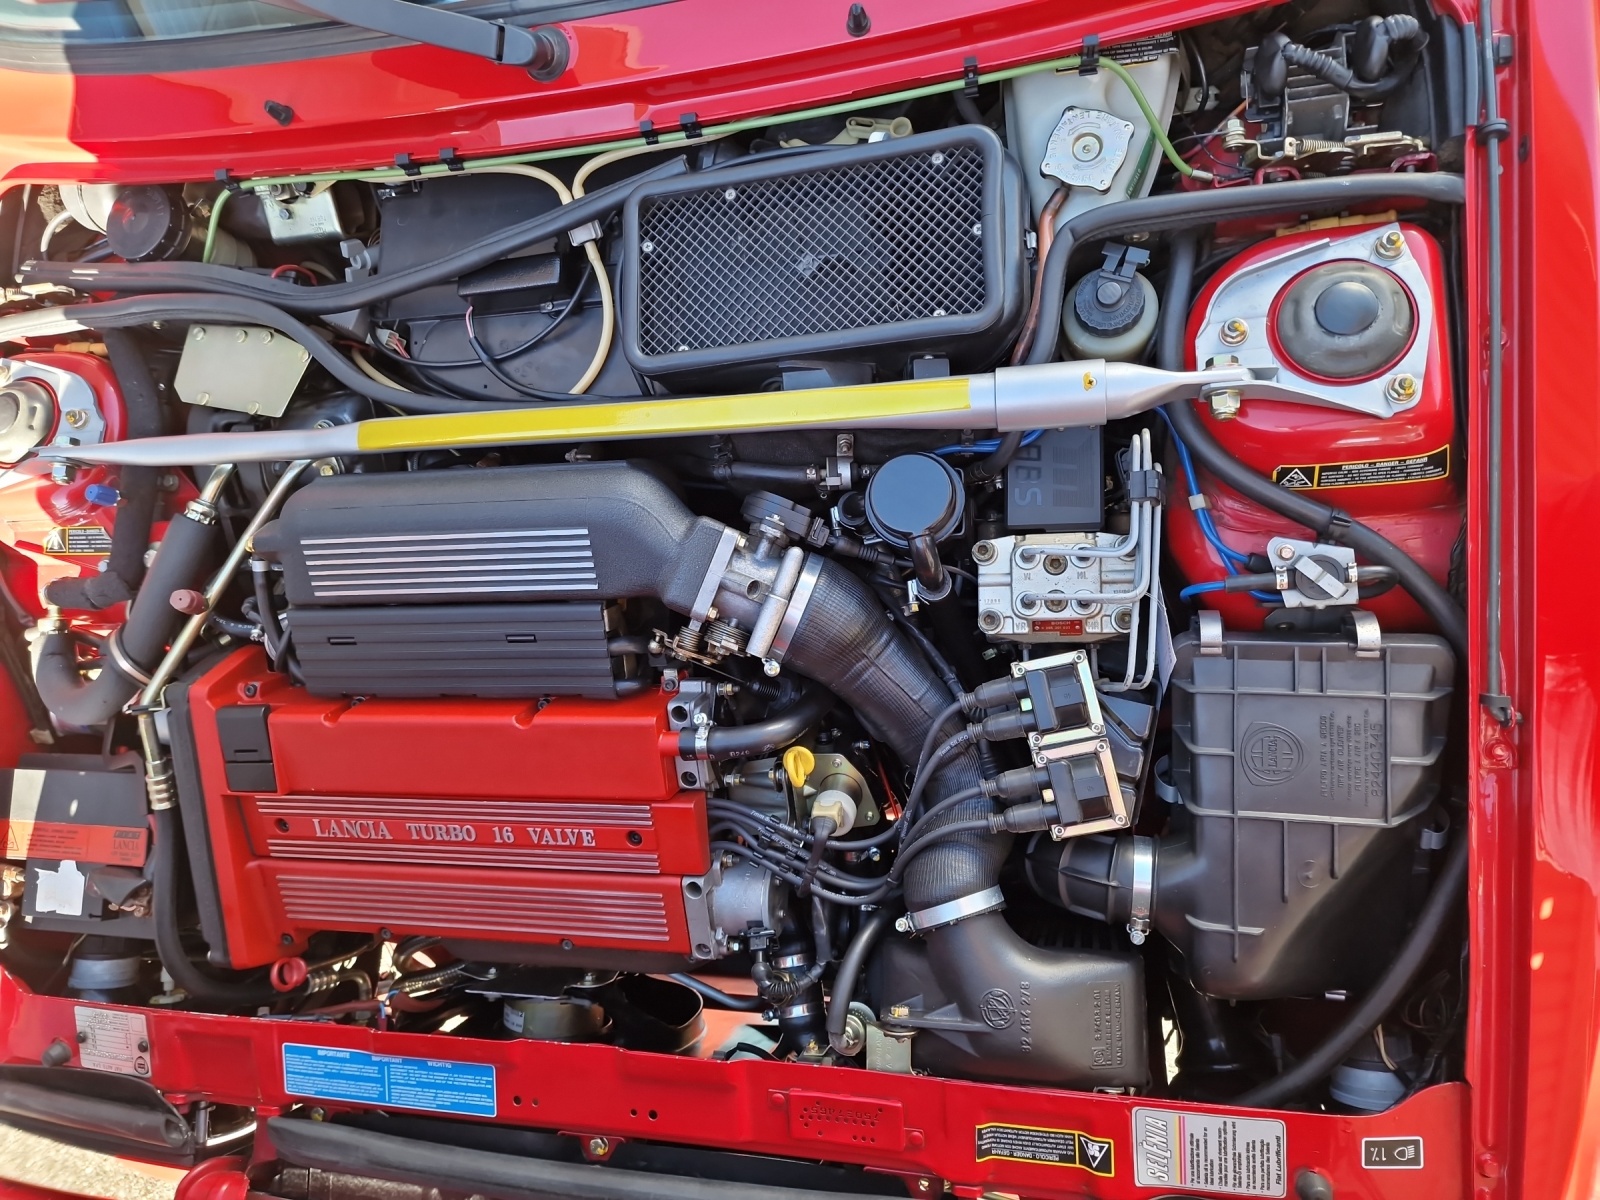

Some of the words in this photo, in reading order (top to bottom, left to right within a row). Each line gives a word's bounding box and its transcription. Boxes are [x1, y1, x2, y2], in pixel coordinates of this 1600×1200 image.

[1015, 620, 1027, 632] VR
[1268, 740, 1278, 768] LANCIA
[312, 818, 393, 840] LANCIA
[406, 823, 476, 842] TURBO
[492, 826, 515, 843] 16
[526, 827, 596, 847] VALVE
[317, 1049, 350, 1058] IMPORTANTE
[372, 1056, 402, 1064] IMPORTANT
[1370, 1147, 1387, 1161] 1%
